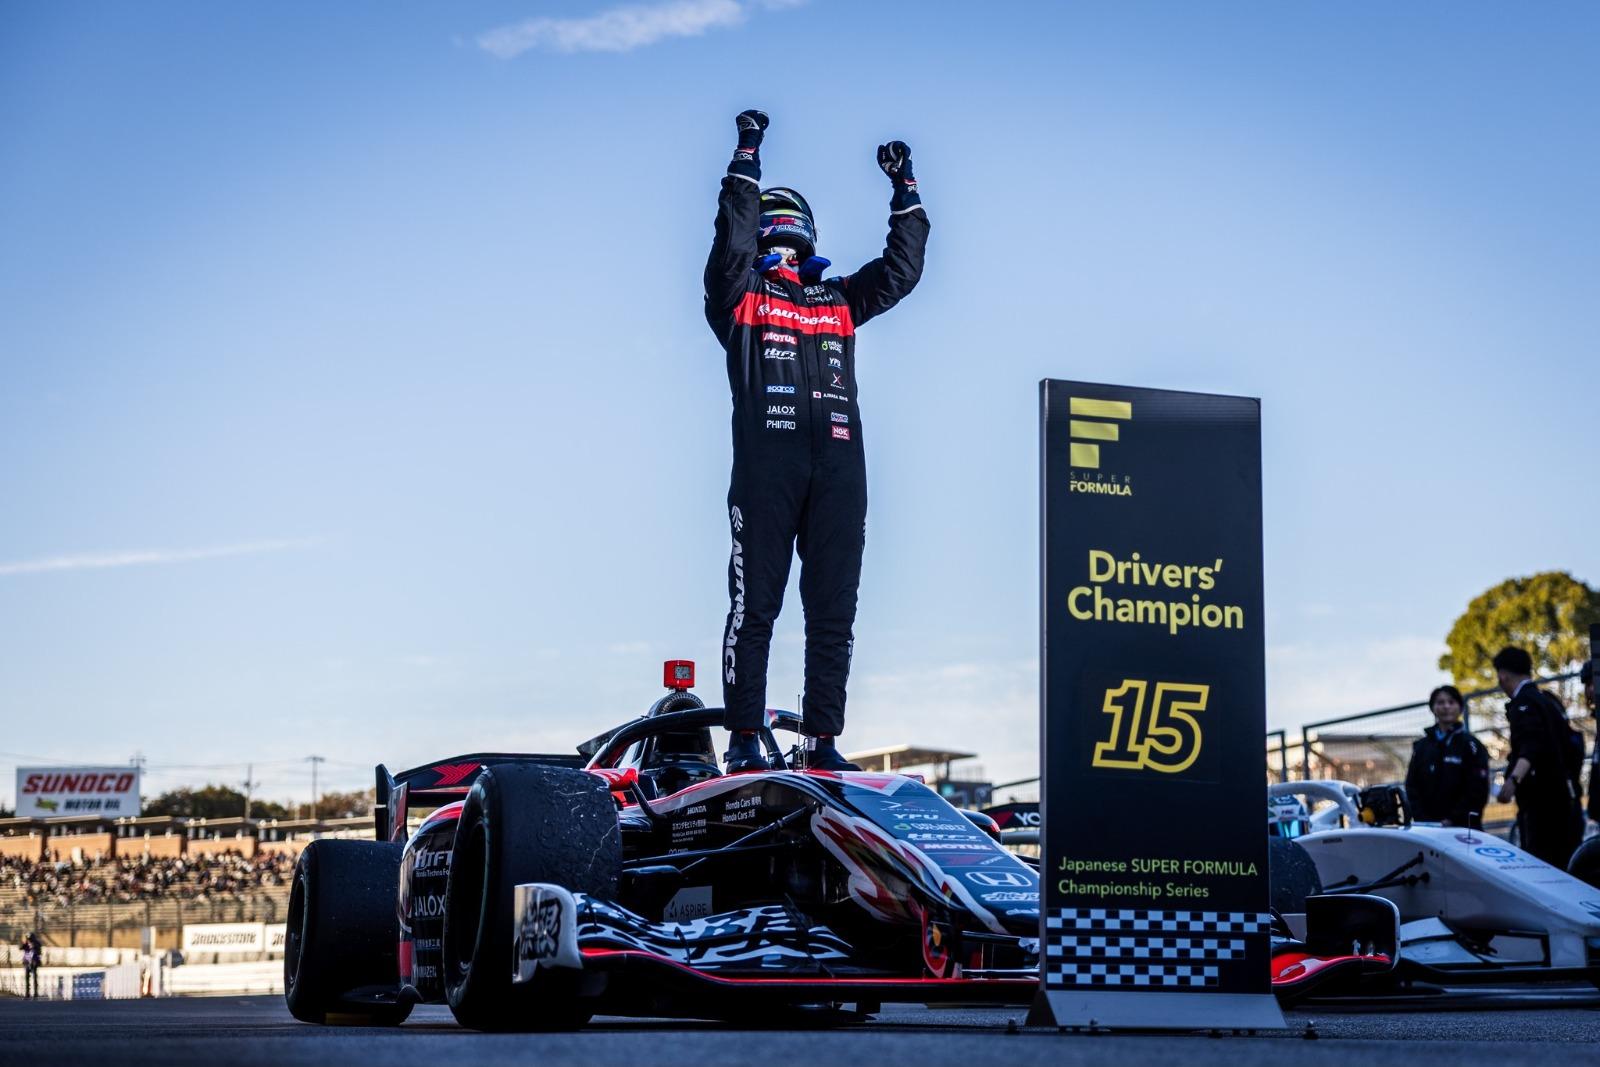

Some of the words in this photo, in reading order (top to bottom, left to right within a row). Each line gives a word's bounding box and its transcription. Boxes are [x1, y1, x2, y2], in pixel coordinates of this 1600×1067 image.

[764, 332, 797, 344] MOTUL
[767, 405, 796, 414] JALOX
[1070, 471, 1130, 484] SUPER
[1070, 481, 1132, 496] FORMULA
[1089, 549, 1223, 590] Drivers'
[1067, 586, 1244, 635] Champion
[1092, 679, 1210, 773] 15
[22, 773, 135, 794] SUNOCO
[725, 801, 740, 811] Honda
[740, 798, 750, 808] Cars
[722, 812, 737, 823] Honda
[737, 810, 748, 821] Cars
[1059, 856, 1127, 874] Japanese
[1131, 858, 1180, 874] SUPER
[1184, 860, 1258, 876] FORMULA
[1058, 879, 1162, 898] Championship
[1165, 882, 1209, 898] Series
[414, 895, 446, 917] JALOX
[680, 903, 706, 916] ASPIRE
